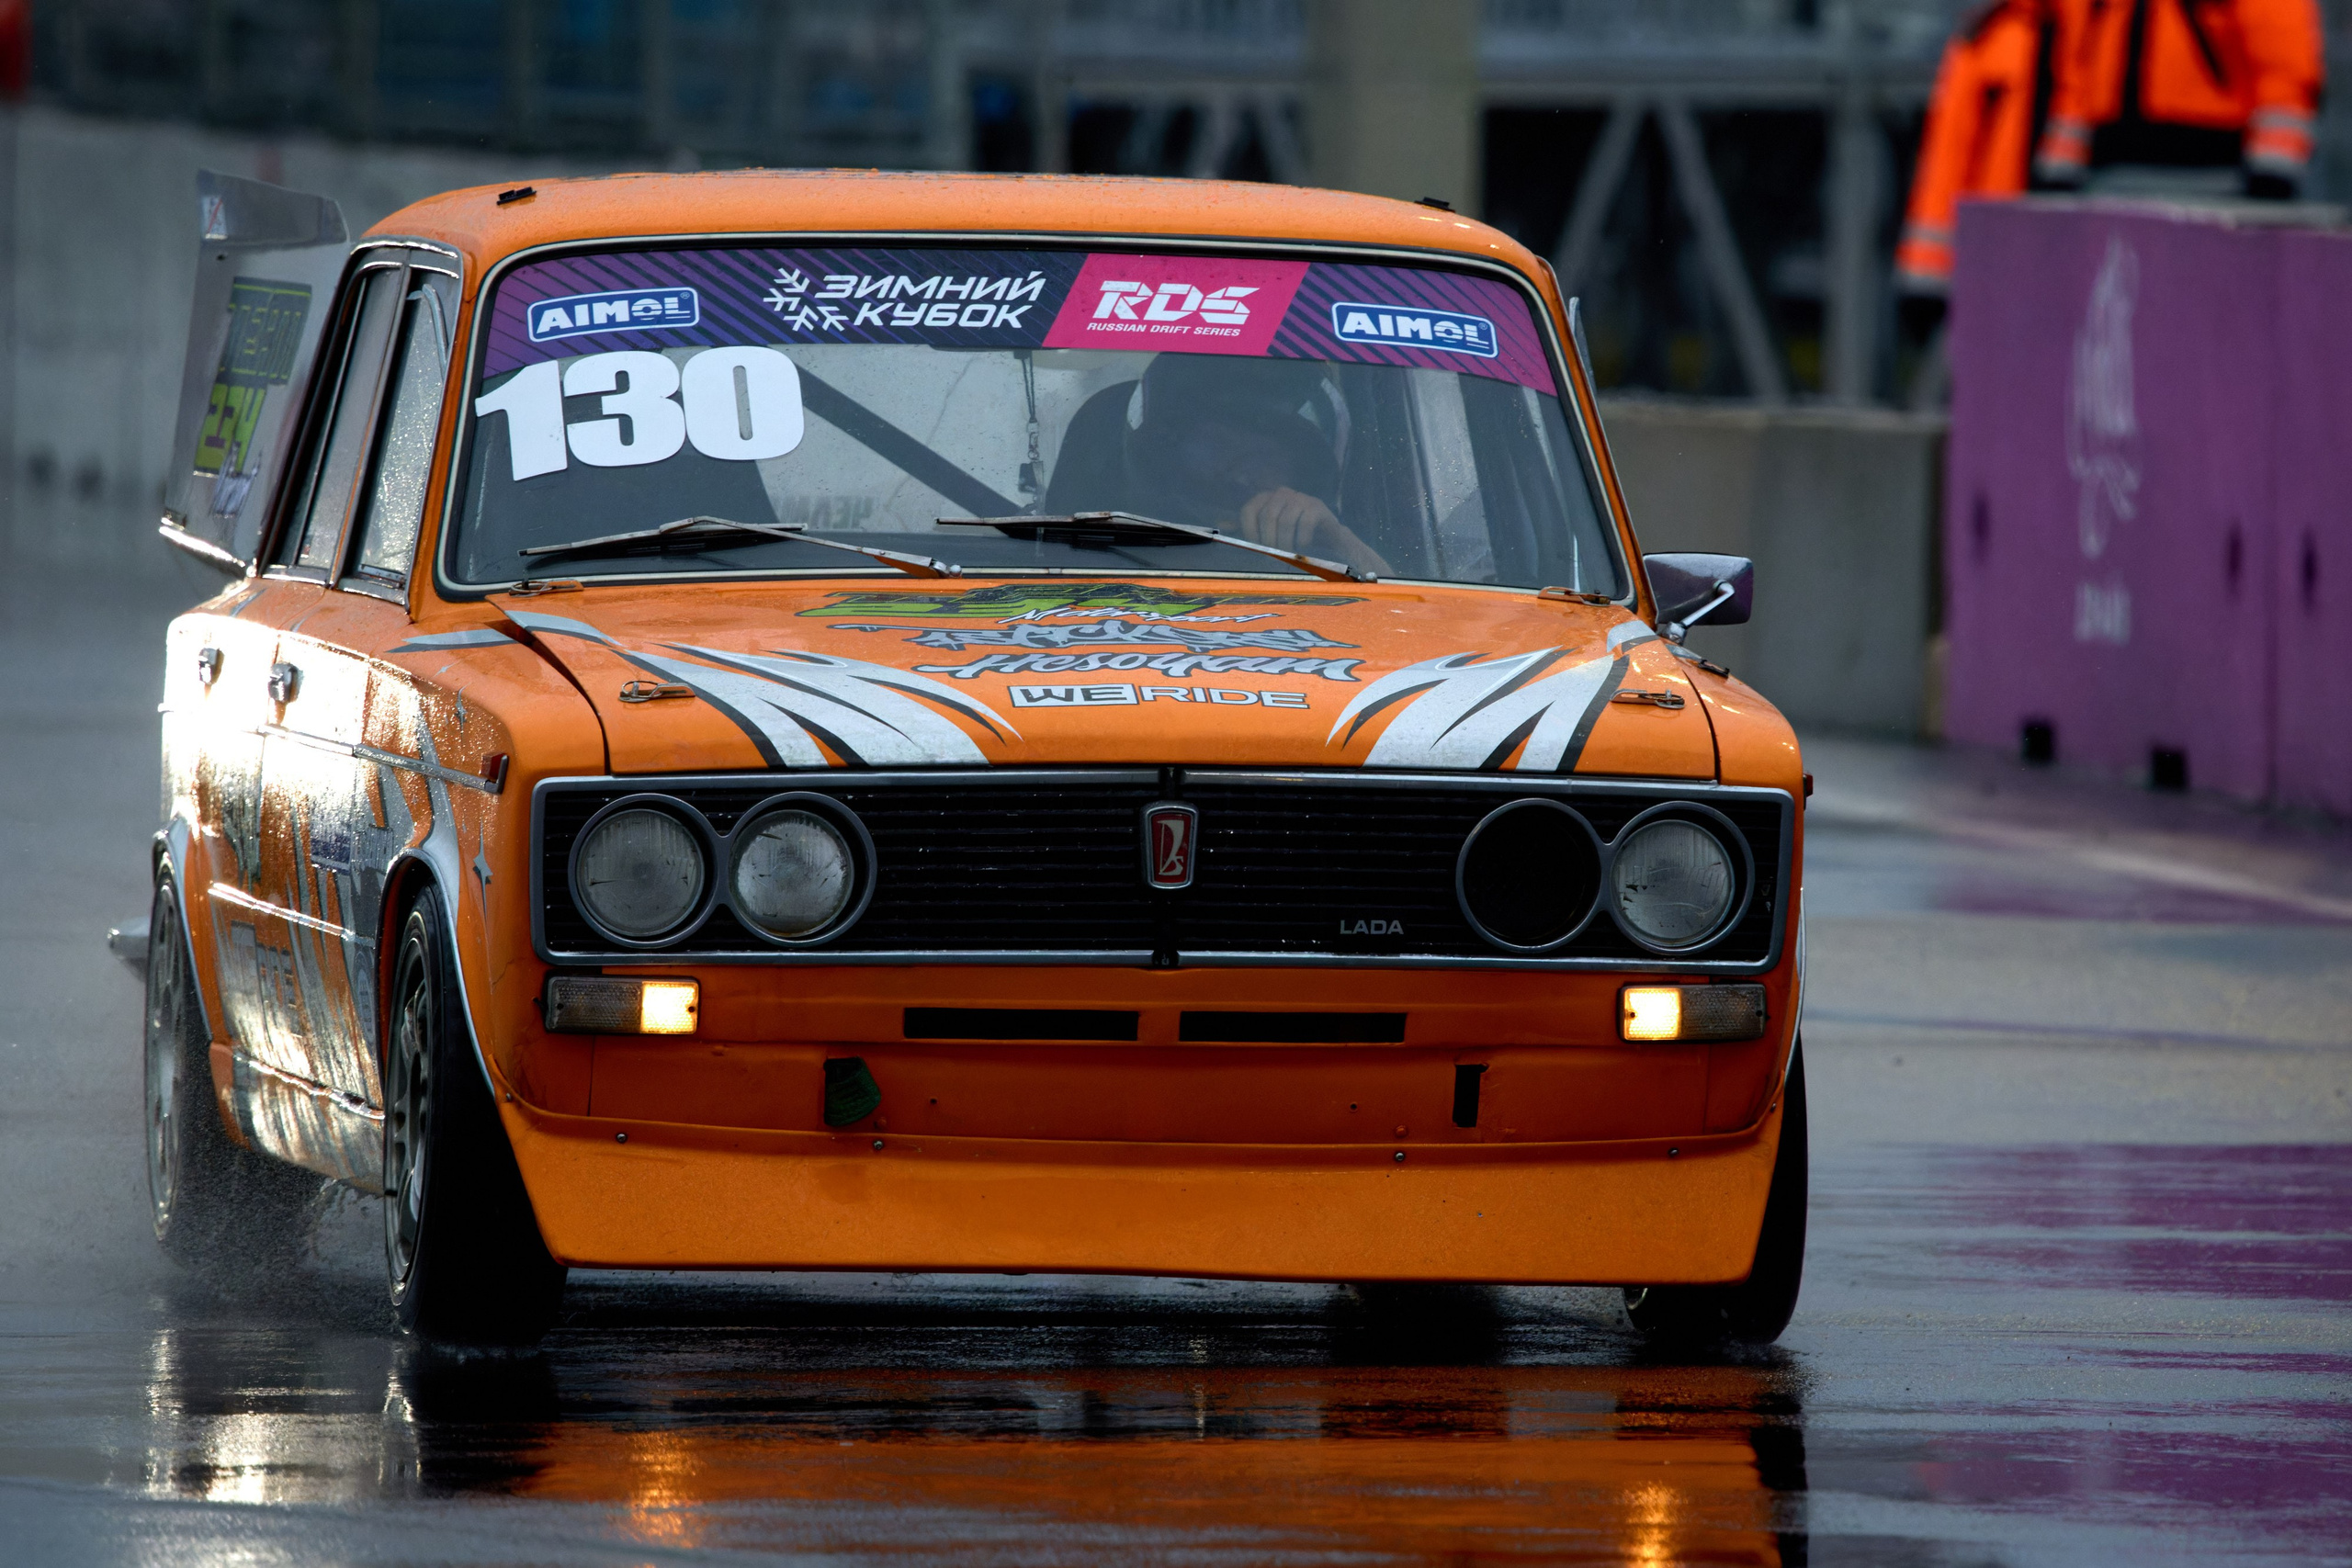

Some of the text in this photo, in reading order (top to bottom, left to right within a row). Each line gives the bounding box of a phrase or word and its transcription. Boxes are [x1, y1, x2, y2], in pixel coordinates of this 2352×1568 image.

[815, 270, 1046, 301] ЗИМНИЙ
[1092, 280, 1260, 324] RDS
[536, 297, 692, 334] AIMOL
[854, 303, 1032, 328] КУБОК
[1086, 321, 1240, 336] RUSSIAN DRIFT SERIES
[1341, 311, 1489, 349] AIMOL
[475, 345, 805, 481] 130
[1340, 920, 1403, 935] LADA
